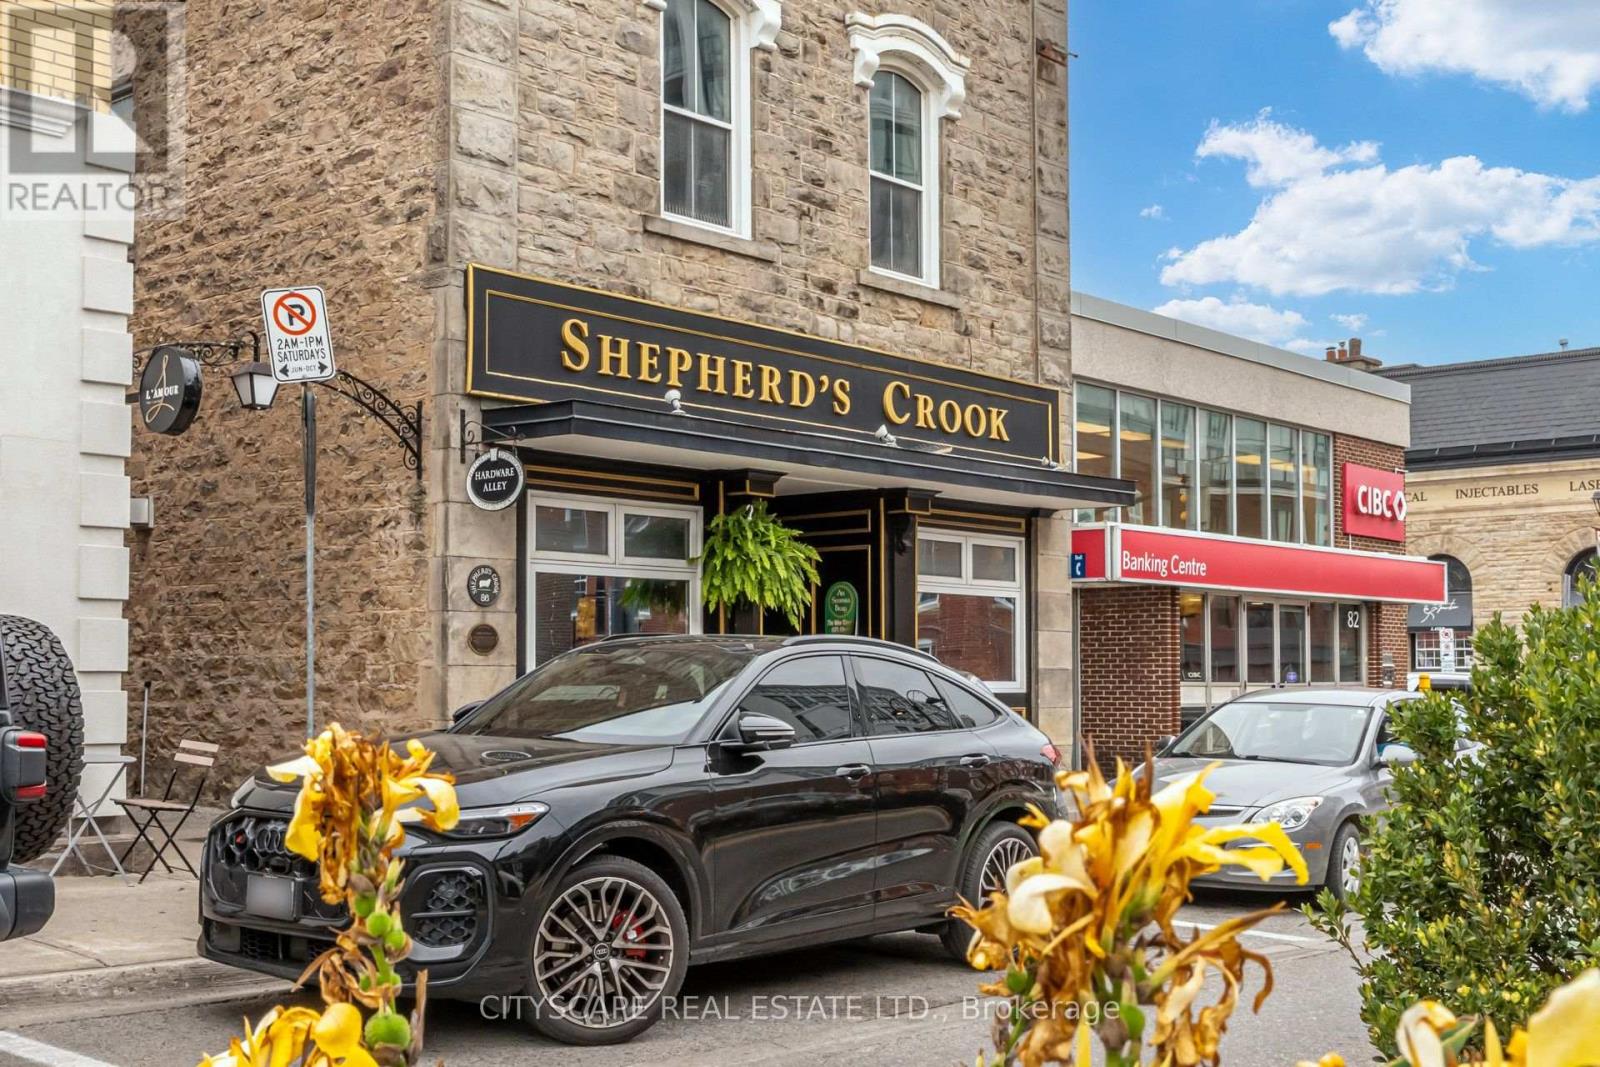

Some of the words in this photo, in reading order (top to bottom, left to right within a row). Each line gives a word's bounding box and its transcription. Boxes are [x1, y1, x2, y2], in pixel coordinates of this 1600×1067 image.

[277, 348, 326, 363] SATURDAYS
[561, 318, 851, 416] SHEPHERD'S
[882, 381, 1010, 442] CROOK
[145, 385, 179, 400] L'AMOUR
[475, 467, 515, 481] HARDWARE
[483, 481, 508, 493] ALLEY
[1455, 483, 1539, 499] INJECTABLES
[1357, 485, 1392, 519] CIBC
[1122, 550, 1168, 577] Banking
[1170, 555, 1207, 576] Centre
[1347, 610, 1360, 629] 82
